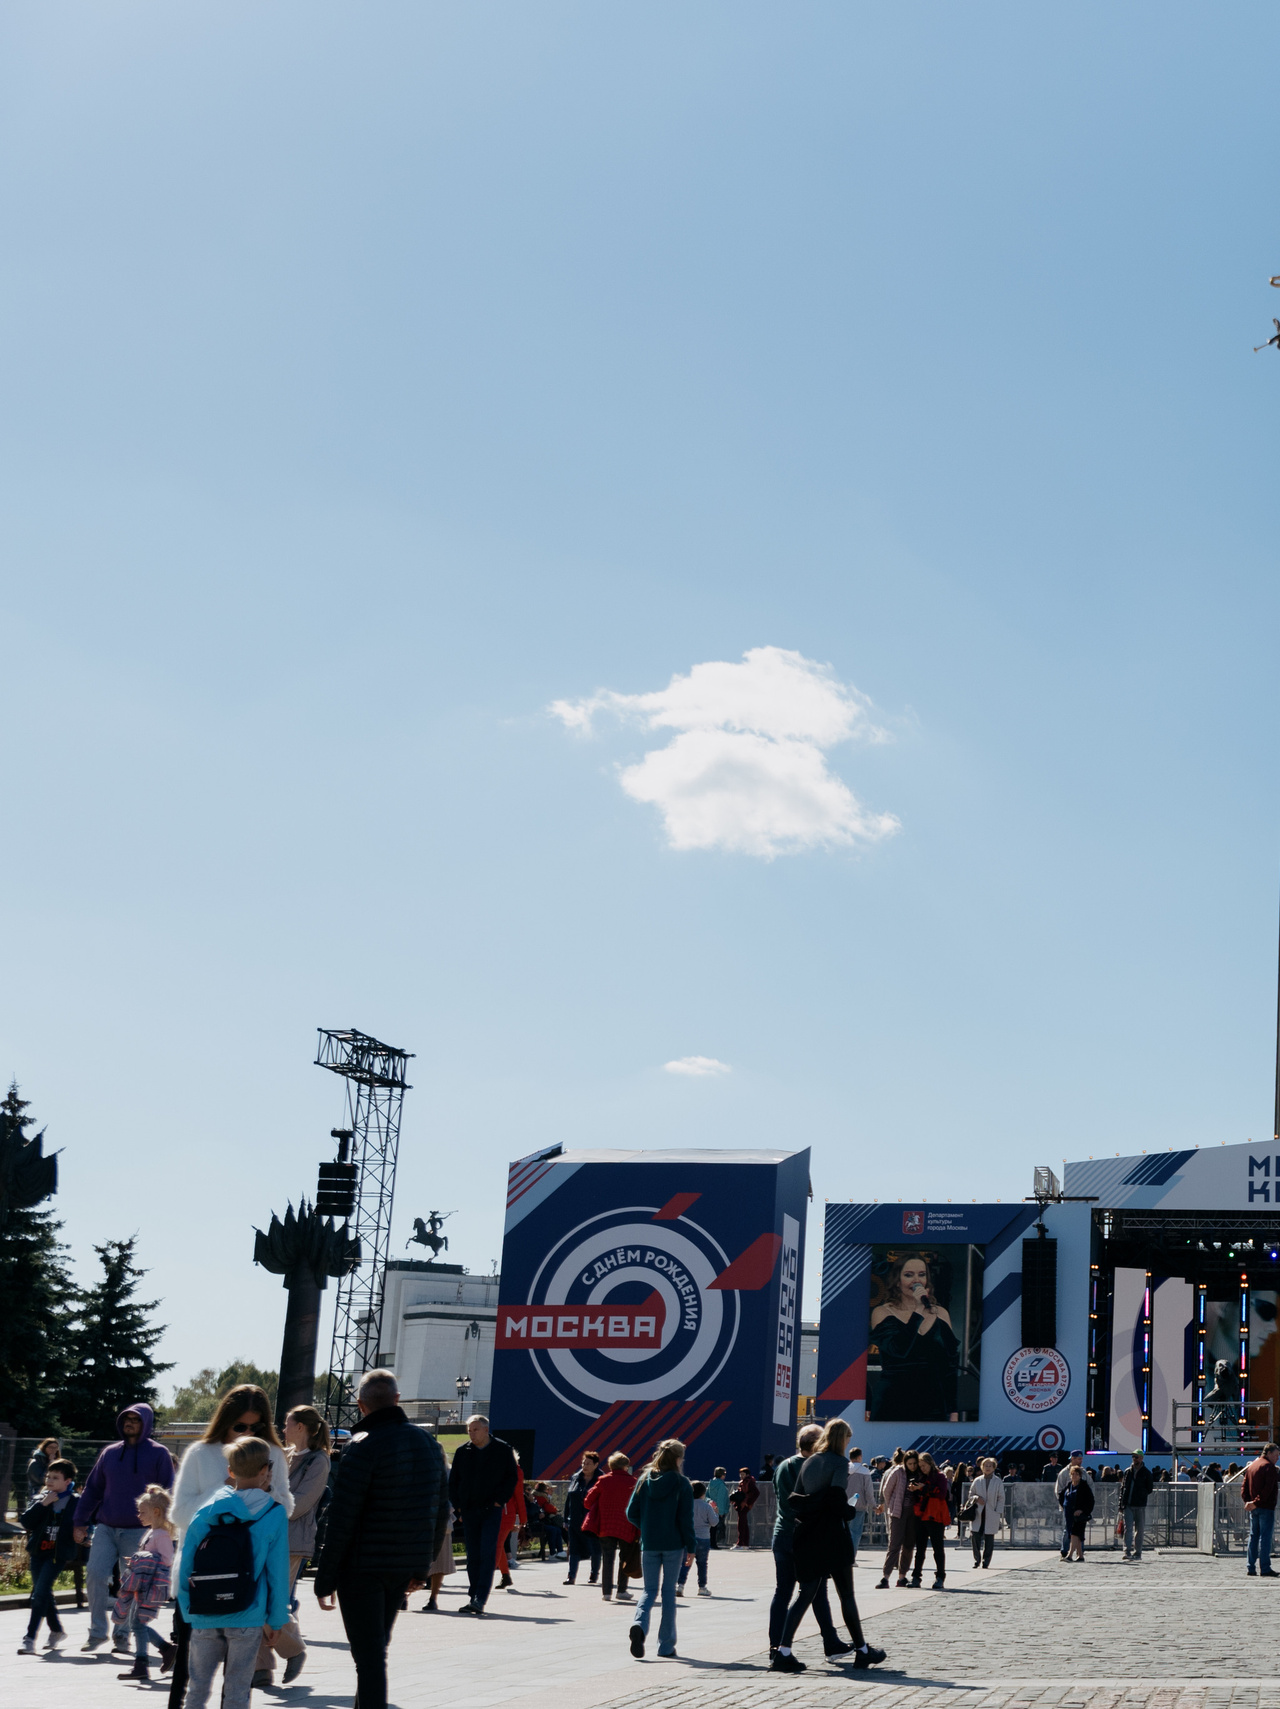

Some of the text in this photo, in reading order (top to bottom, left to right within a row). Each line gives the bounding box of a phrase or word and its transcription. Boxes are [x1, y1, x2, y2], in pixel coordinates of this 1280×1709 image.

[582, 1248, 699, 1331] С ДНЁМ РОЖДЕНИЯ
[505, 1316, 656, 1338] МОСКВА
[776, 1363, 791, 1389] 875
[1006, 1349, 1032, 1388] МОСКВА 875
[1018, 1370, 1055, 1382] 875
[1042, 1348, 1068, 1387] МОСКВА 875
[1013, 1395, 1058, 1409] ДЕНЬ ГОРОДА
